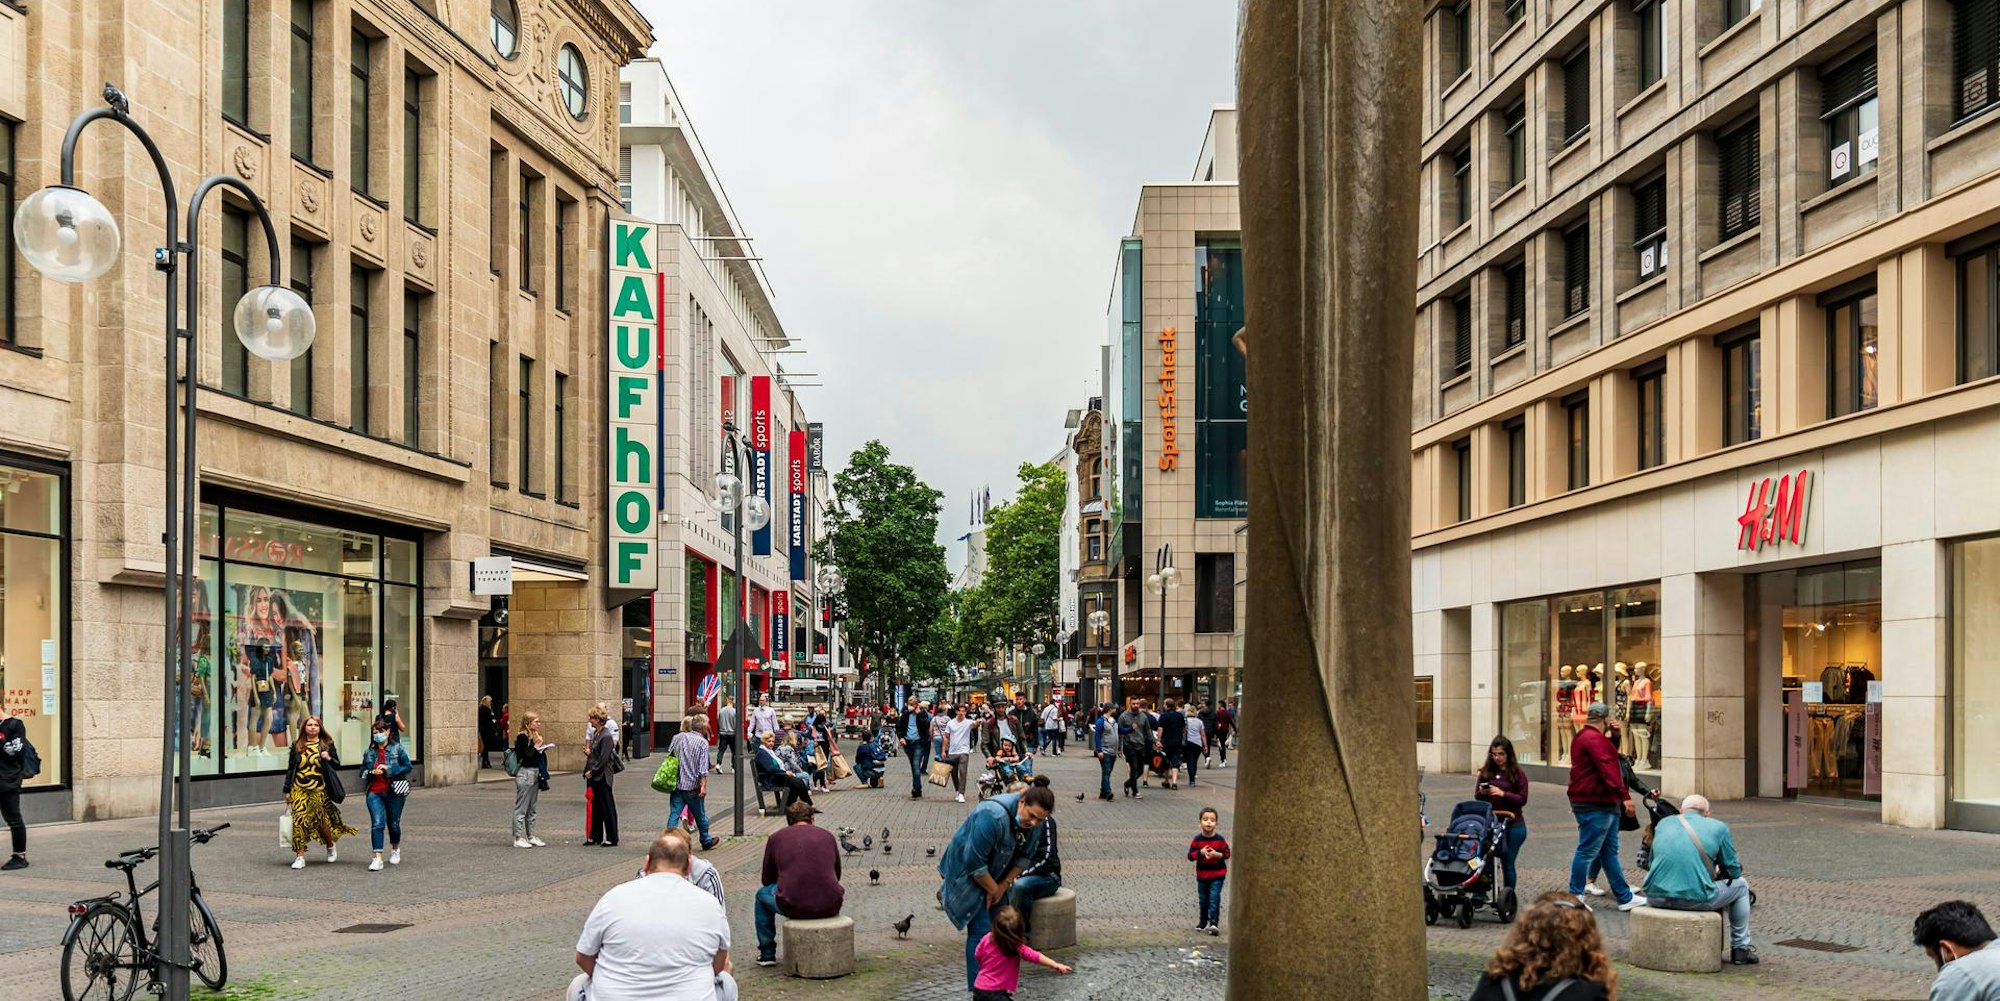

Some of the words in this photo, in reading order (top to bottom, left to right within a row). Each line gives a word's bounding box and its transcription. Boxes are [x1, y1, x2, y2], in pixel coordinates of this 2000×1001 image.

[1158, 327, 1180, 471] SportScheck
[755, 409, 768, 448] sports
[812, 438, 822, 467] BABOR
[793, 459, 803, 491] sports
[793, 493, 801, 546] KARSTADT
[1738, 469, 1812, 551] H&M
[11, 708, 36, 717] OPEN
